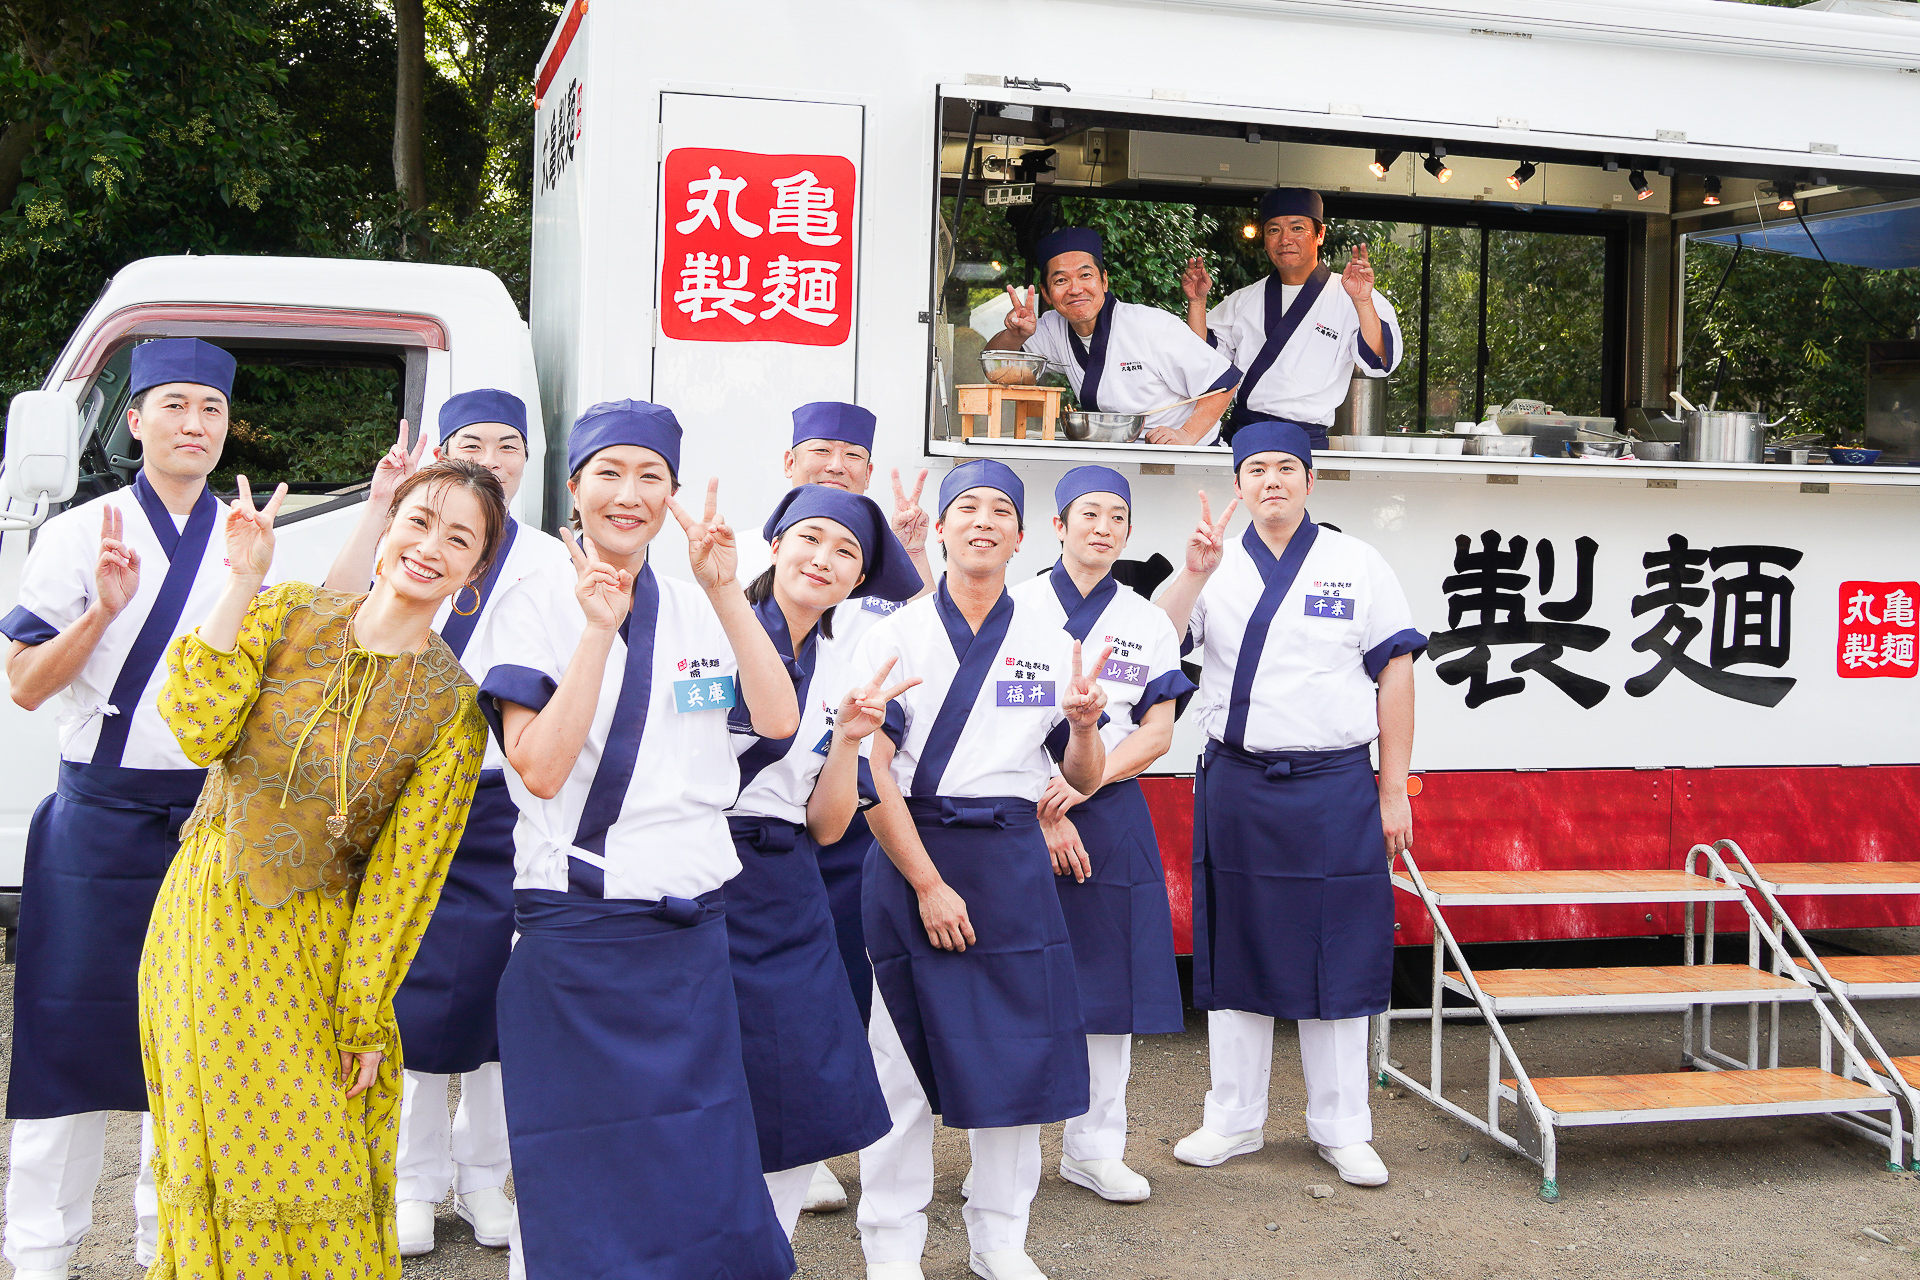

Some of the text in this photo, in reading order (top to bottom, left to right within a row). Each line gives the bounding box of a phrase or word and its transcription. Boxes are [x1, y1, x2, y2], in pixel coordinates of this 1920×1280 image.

[541, 77, 576, 197] 丸亀製麺
[675, 165, 843, 247] 丸亀
[673, 251, 842, 328] 製麺
[1313, 598, 1346, 617] 千葉
[1842, 588, 1917, 628] 丸亀
[1015, 659, 1050, 672] 丸亀製麺
[1842, 631, 1916, 669] 製麺
[1106, 662, 1141, 682] 山梨
[687, 681, 727, 708] 兵庫
[1005, 683, 1046, 704] 福井
